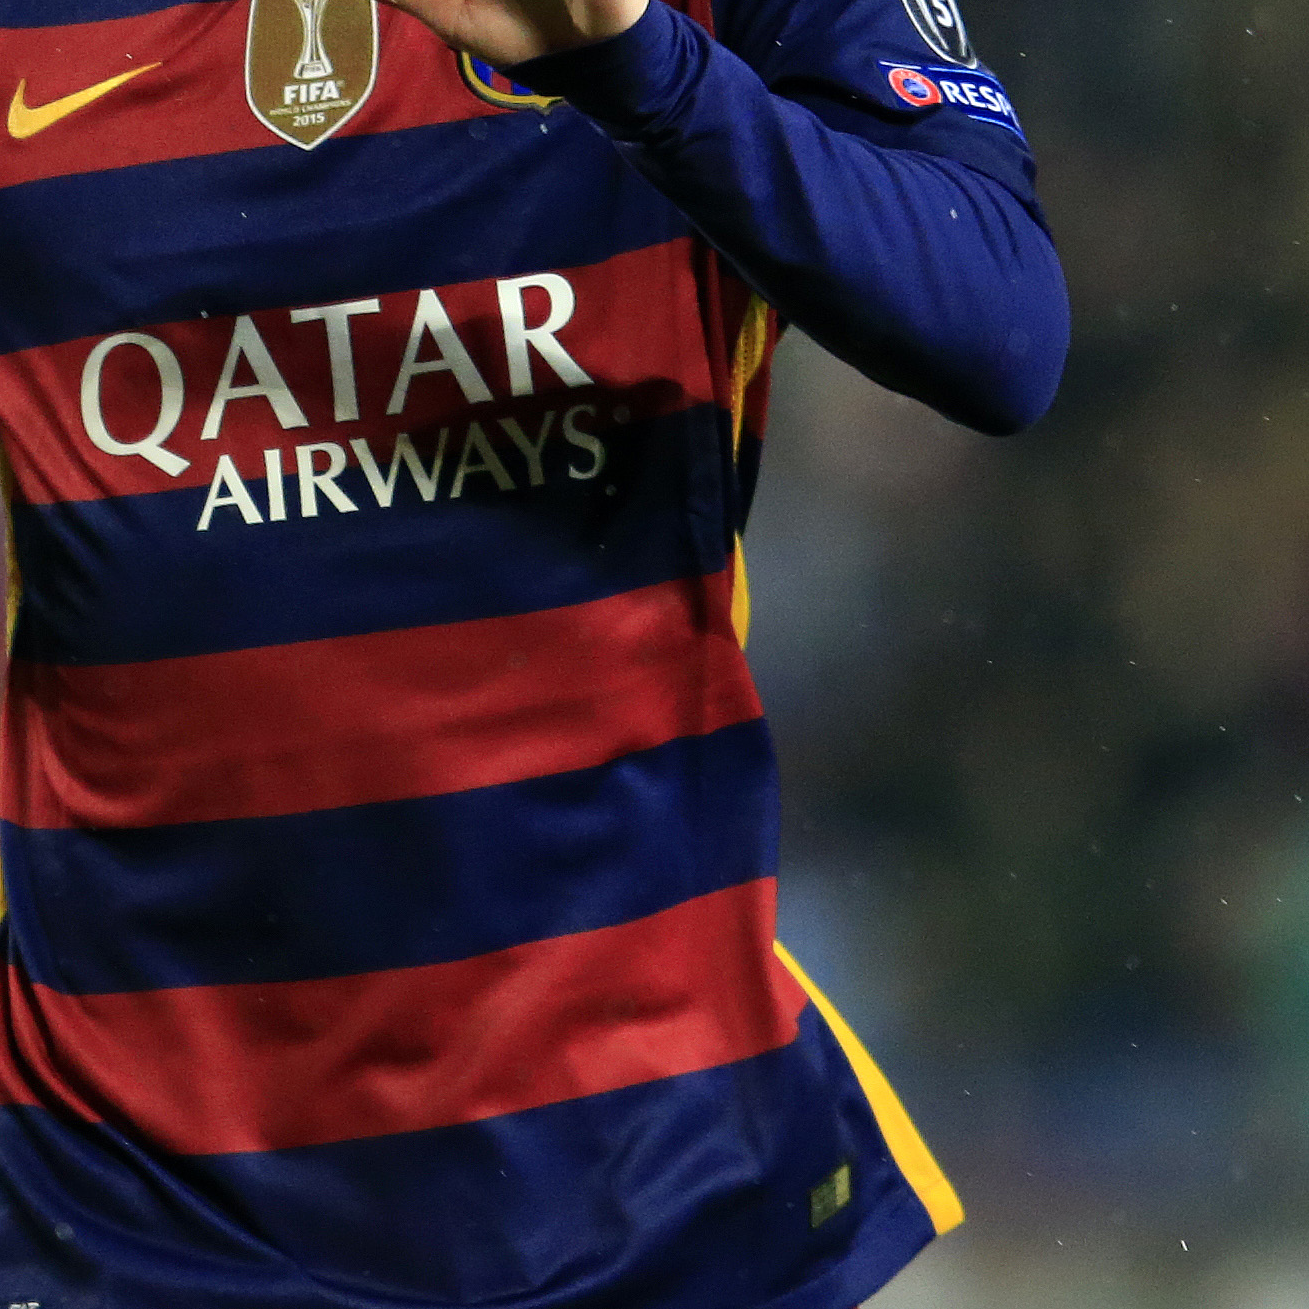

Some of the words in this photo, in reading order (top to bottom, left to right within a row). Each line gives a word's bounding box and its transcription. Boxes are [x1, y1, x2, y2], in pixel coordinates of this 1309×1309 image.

[284, 80, 340, 105] FIFA
[293, 112, 326, 127] 2015
[80, 272, 595, 477] QATAR
[196, 403, 606, 532] AIRWAYS
